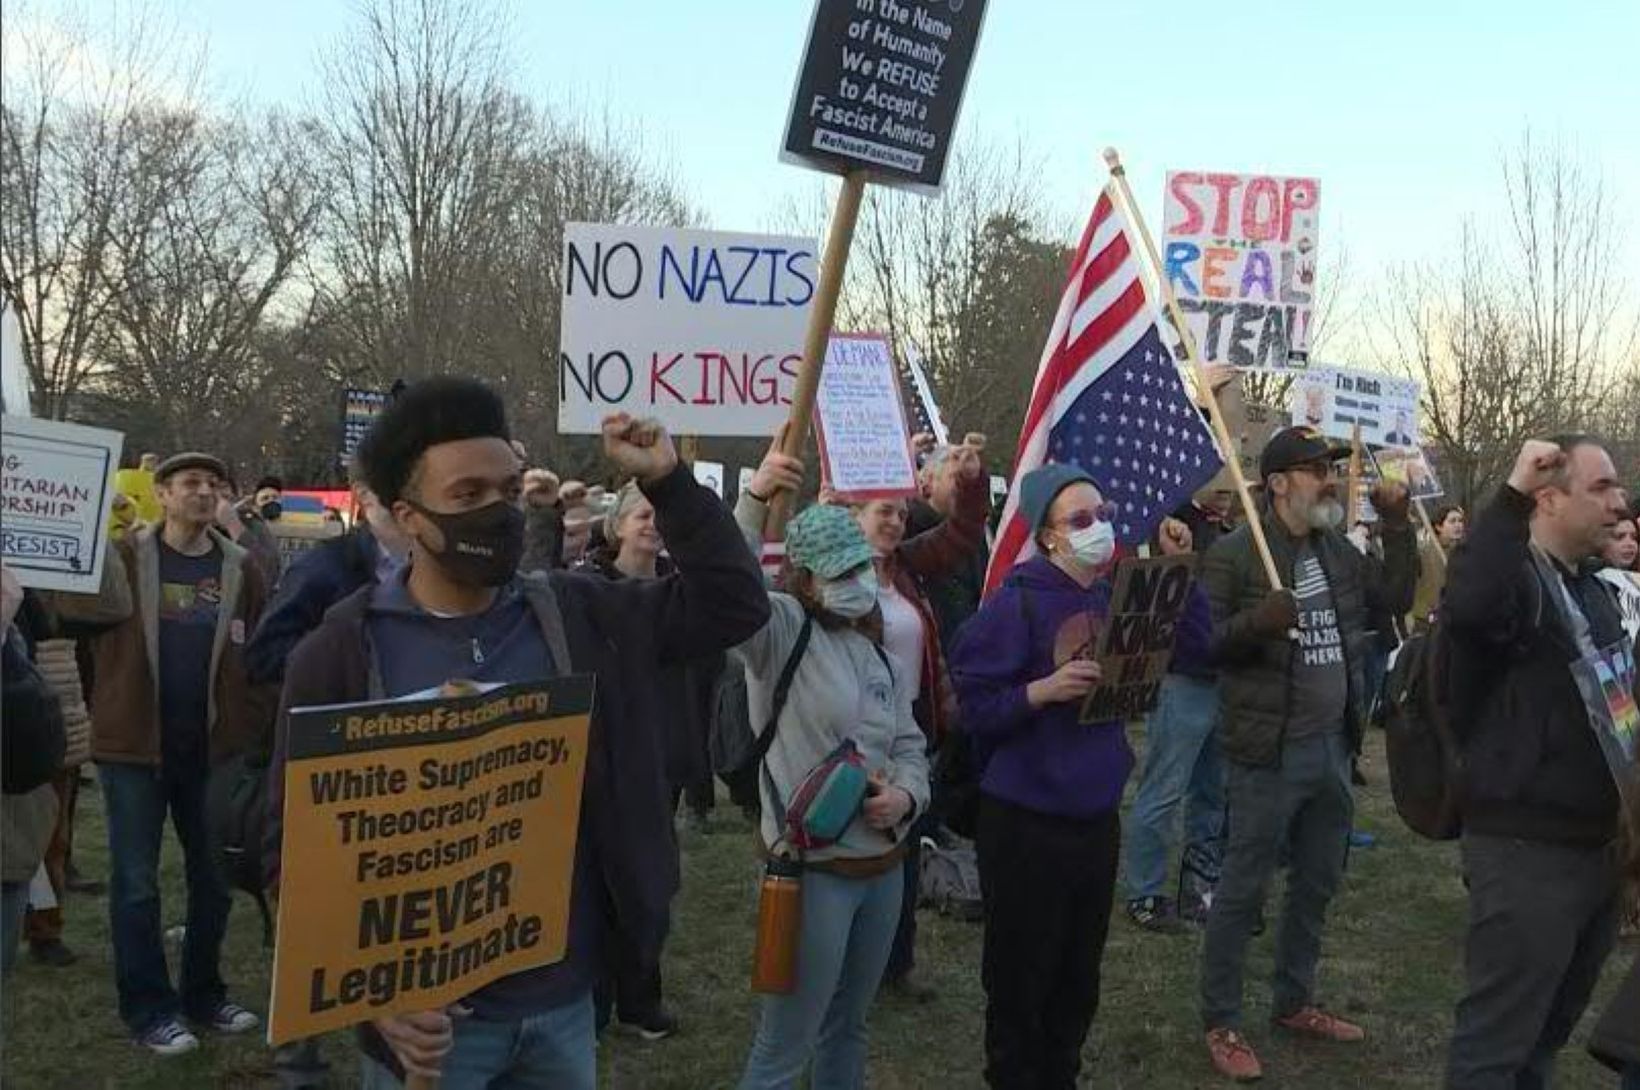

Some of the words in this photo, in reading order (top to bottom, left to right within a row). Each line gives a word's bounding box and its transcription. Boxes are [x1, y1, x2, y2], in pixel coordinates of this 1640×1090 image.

[848, 20, 870, 39] of
[873, 24, 945, 72] Humanity
[880, 0, 909, 25] the
[912, 7, 951, 40] Name
[842, 46, 872, 75] We
[877, 58, 940, 97] REFUSE
[810, 96, 878, 133] Fascist
[880, 116, 936, 149] America
[840, 77, 858, 100] to
[863, 82, 917, 119] Accept
[919, 105, 927, 120] a
[1168, 172, 1318, 243] STOP
[566, 242, 643, 300] NO
[659, 244, 814, 306] NAZIS
[1165, 241, 1311, 304] REAL
[560, 350, 633, 404] NO
[649, 350, 803, 405] KINGS
[1, 453, 21, 472] G
[3, 476, 89, 502] ITARIAN
[1, 532, 74, 558] RESIST
[1121, 565, 1189, 618] NO
[1297, 610, 1308, 628] E
[345, 691, 548, 741] RefuseFascism.org
[310, 765, 407, 805] White
[419, 734, 570, 793] Supremacy,
[336, 789, 489, 845] Theocracy
[495, 770, 544, 808] and
[357, 833, 478, 883] Fascism
[485, 818, 523, 852] are
[358, 861, 513, 950] NEVER
[309, 914, 543, 1015] Legitimate
